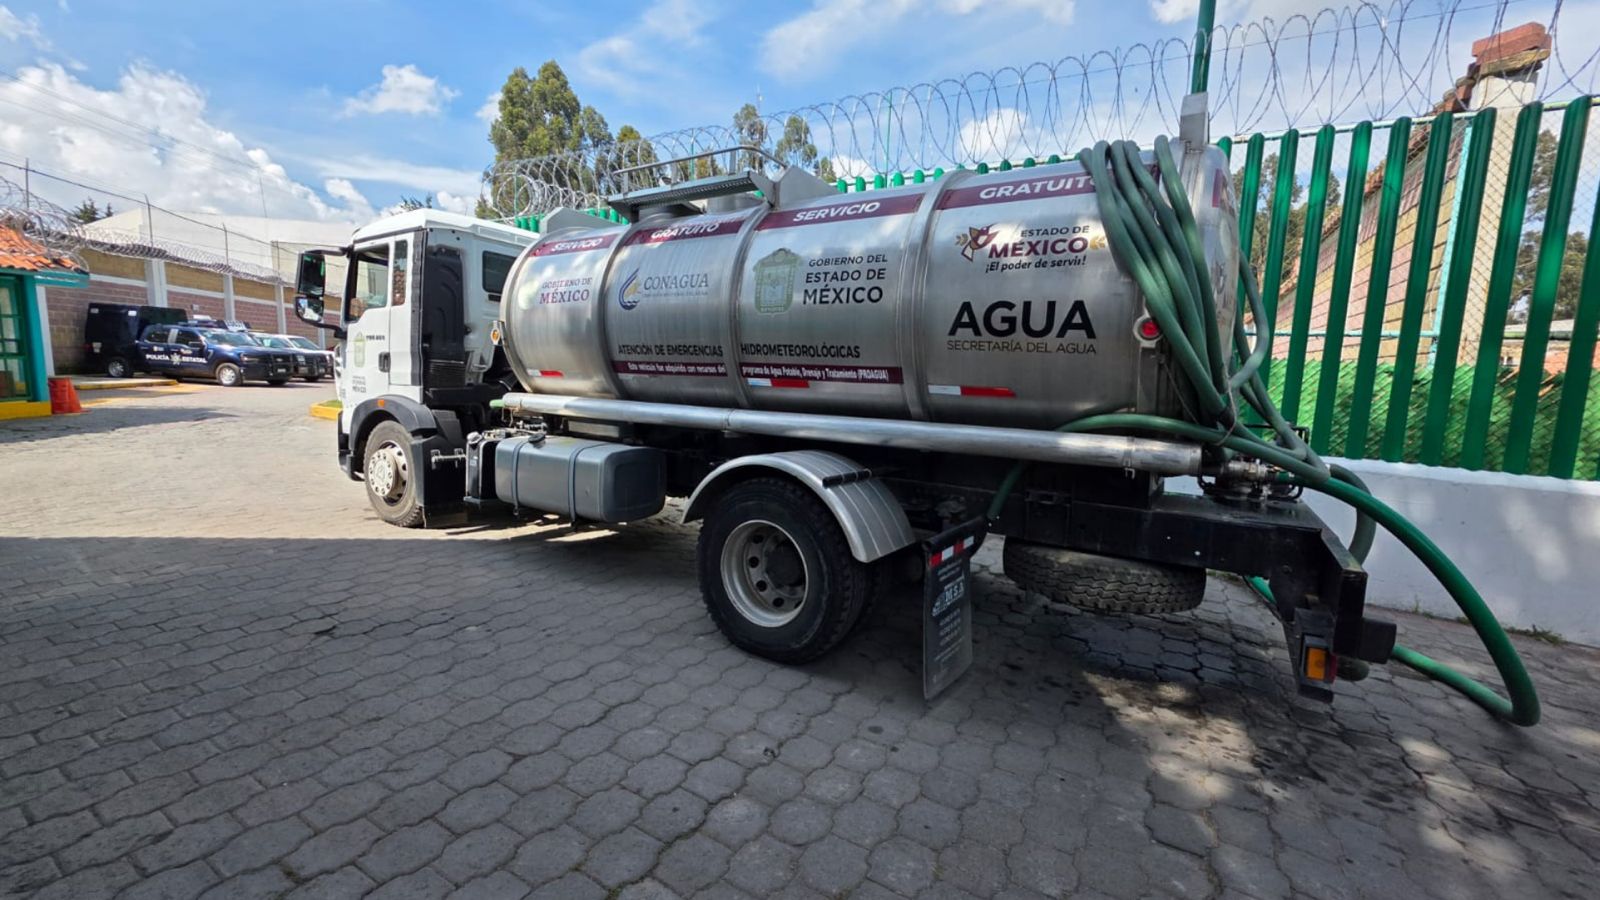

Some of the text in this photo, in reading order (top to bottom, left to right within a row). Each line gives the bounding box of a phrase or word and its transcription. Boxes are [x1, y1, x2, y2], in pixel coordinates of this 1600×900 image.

[793, 202, 880, 222] SERVICIO
[651, 222, 720, 239] GRATUITO
[1021, 226, 1090, 238] ESTADO DE
[551, 238, 603, 252] SERVICIO
[988, 237, 1089, 259] MÉXICO
[809, 254, 888, 267] GOBIERNO DEL
[1001, 261, 1031, 272] poder
[1034, 258, 1048, 268] de
[542, 277, 593, 289] GOBIERNO DE
[644, 273, 709, 291] CONAGUA
[805, 268, 886, 284] ESTADO DE
[539, 289, 590, 305] MÉXICO
[803, 284, 883, 305] MÉXICO
[948, 300, 1097, 339] AGUA
[618, 343, 860, 358] ATENCIÓN DE EMERGENCIAS HIDROMETEOROLÓGICAS
[947, 340, 1097, 355] SECRETARÍA DEL AGUA
[146, 353, 170, 361] POLICÍA
